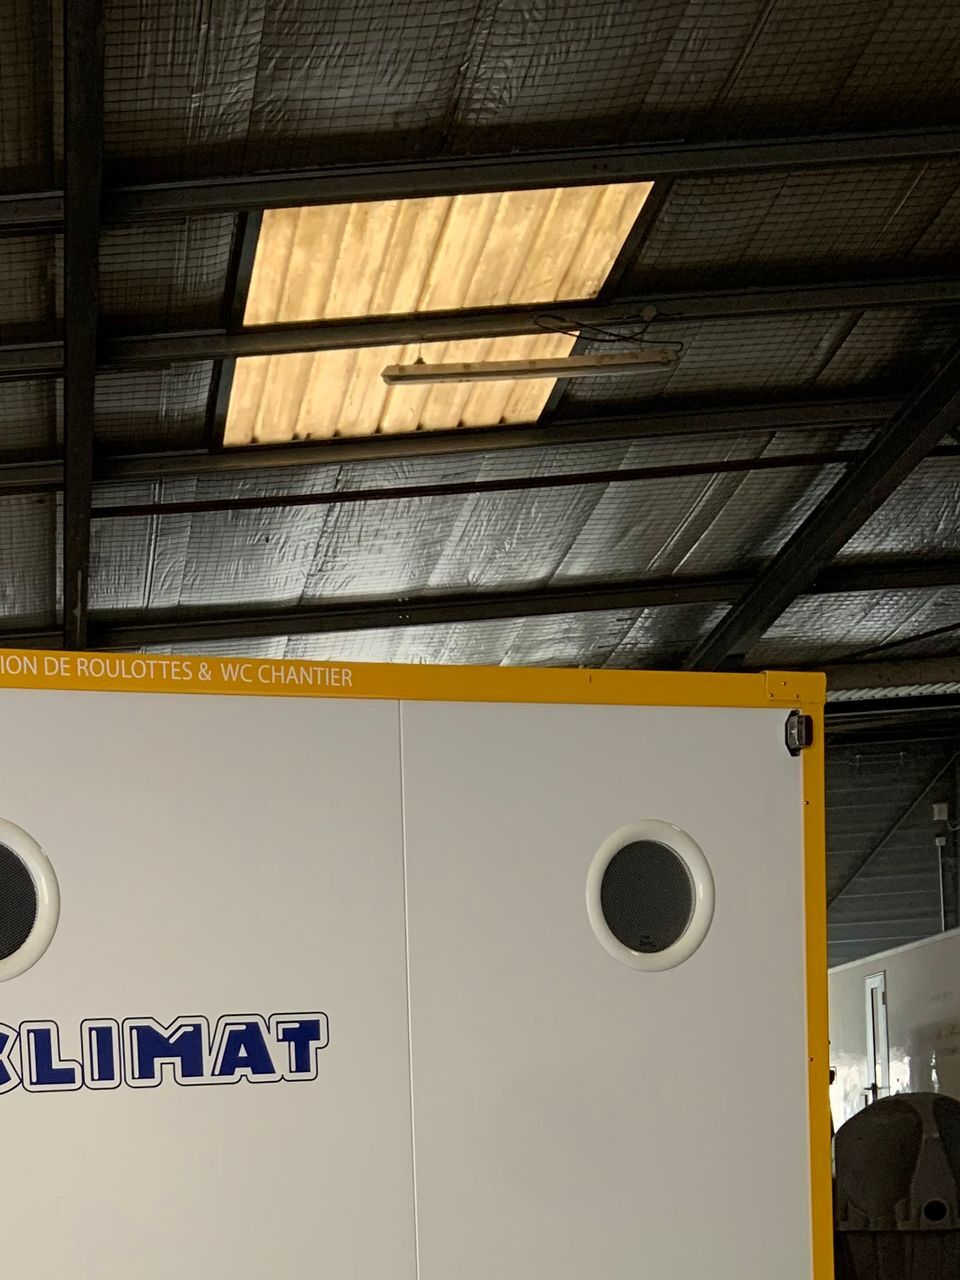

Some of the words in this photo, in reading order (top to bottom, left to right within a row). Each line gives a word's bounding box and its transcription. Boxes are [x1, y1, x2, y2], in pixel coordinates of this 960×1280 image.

[44, 656, 70, 676] DE
[76, 658, 194, 680] ROULOTTES
[197, 662, 212, 680] &
[220, 663, 252, 682] WC
[258, 665, 353, 688] CHANTIER
